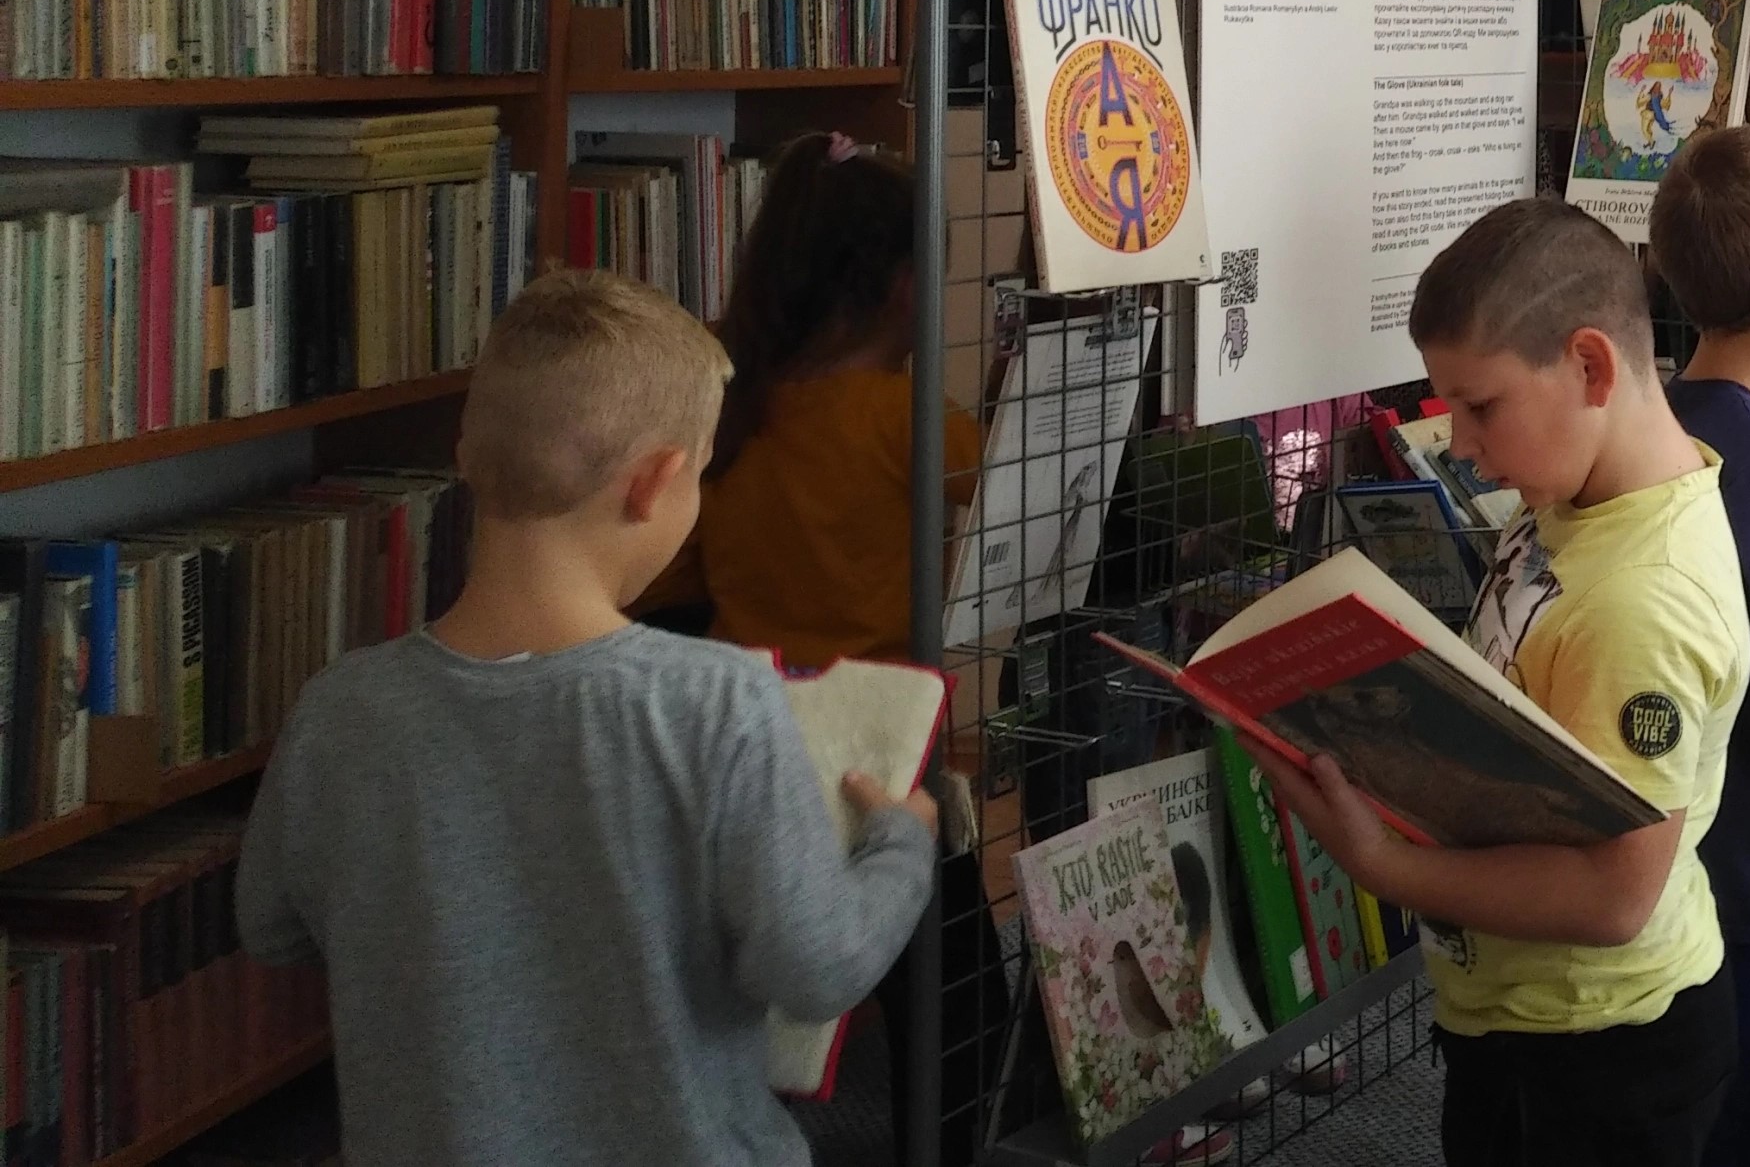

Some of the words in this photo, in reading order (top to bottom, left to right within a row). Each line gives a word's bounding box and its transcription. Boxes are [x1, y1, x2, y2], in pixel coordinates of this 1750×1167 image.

[1373, 80, 1385, 90] The
[1386, 80, 1405, 90] Glove
[1406, 79, 1437, 91] (Ukrainian
[1575, 198, 1651, 214] CTIBOROV
[1633, 707, 1673, 727] COOL
[1633, 724, 1670, 743] VIBE
